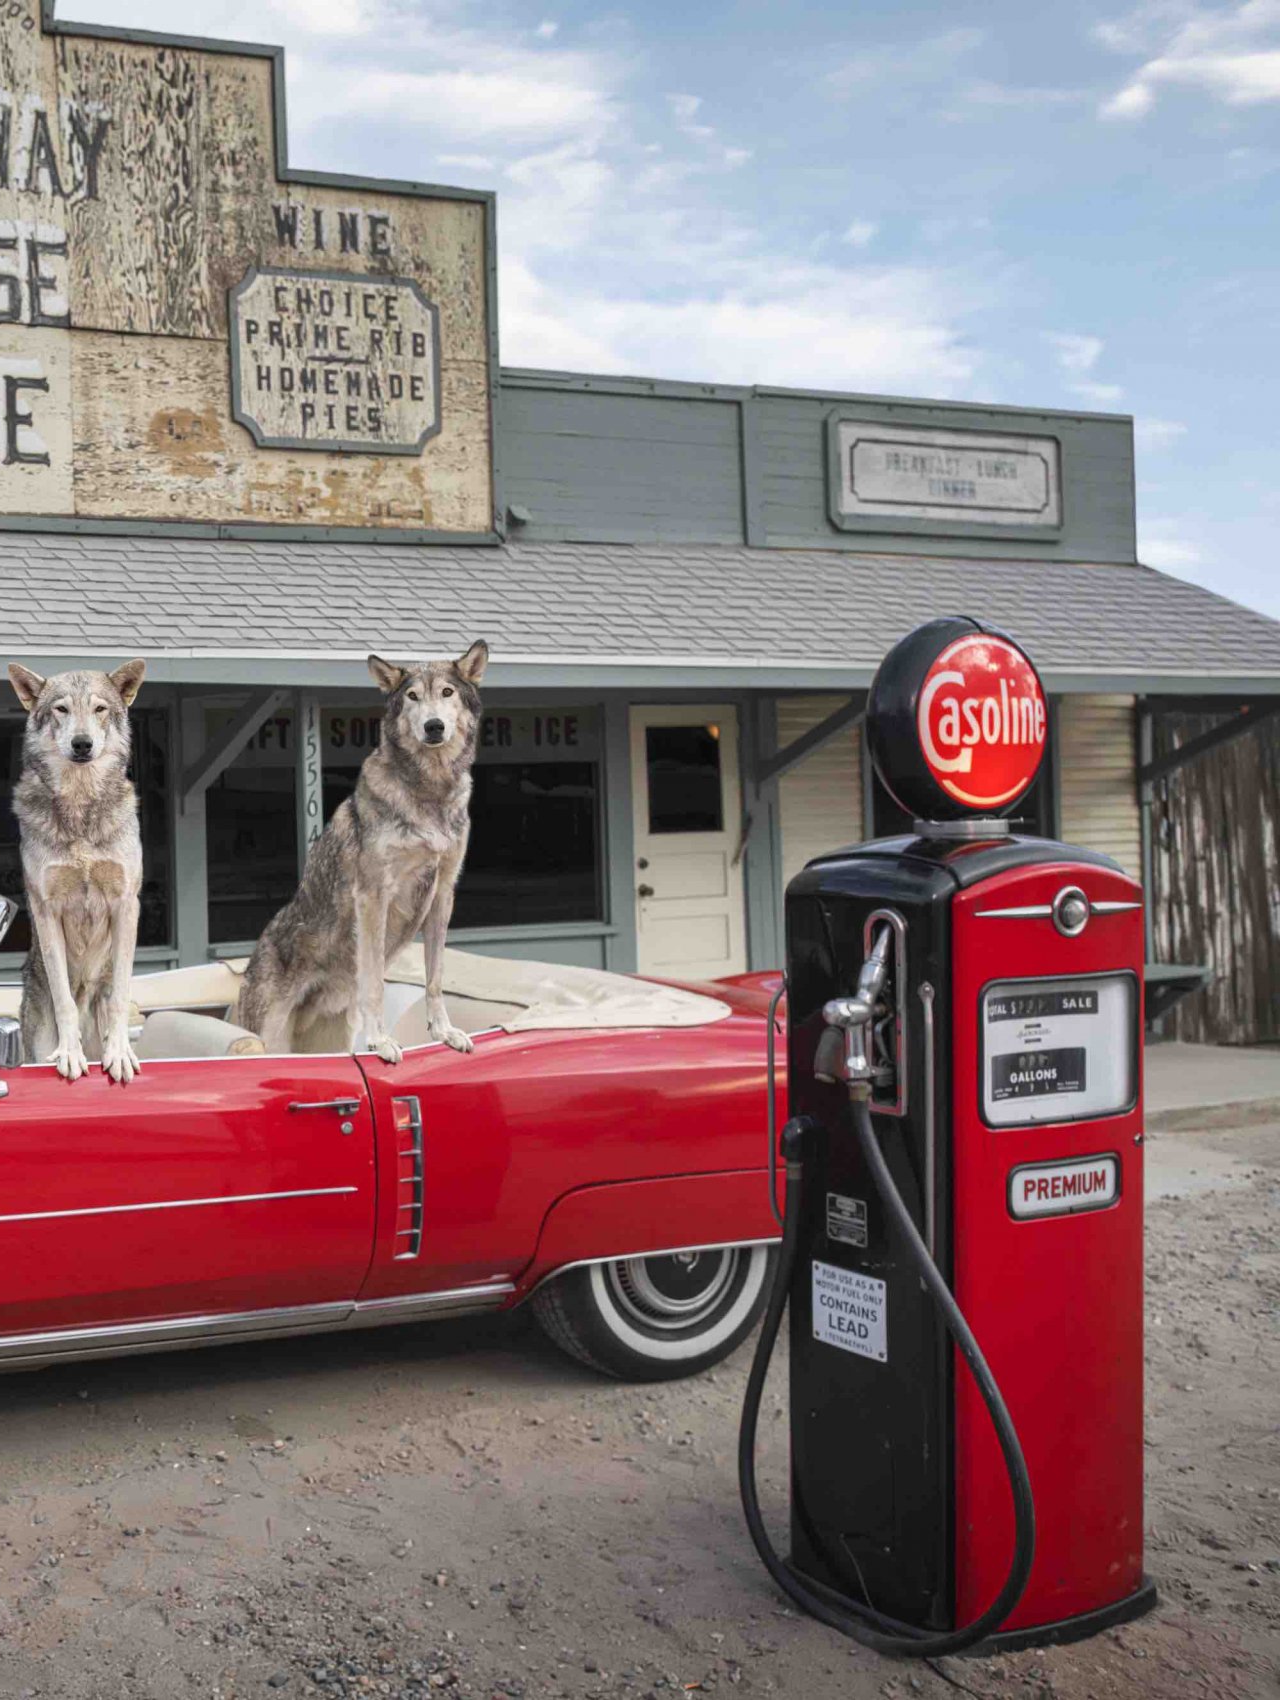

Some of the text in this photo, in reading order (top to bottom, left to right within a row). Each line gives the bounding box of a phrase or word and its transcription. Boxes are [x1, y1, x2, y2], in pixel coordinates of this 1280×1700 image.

[272, 203, 392, 256] WINE
[274, 285, 399, 322] CHOICE
[245, 318, 426, 358] PRIME RIB
[257, 364, 425, 402] HOMEMADE
[301, 402, 382, 433] PIES
[331, 717, 381, 748] SOD
[533, 714, 579, 747] ICE
[919, 671, 1046, 773] Gasoline
[1062, 996, 1093, 1010] SALE
[1009, 1067, 1058, 1084] GALLONS
[1023, 1168, 1107, 1202] PREMIUM
[816, 1279, 884, 1306] MOTOR FUEL ONLY
[822, 1268, 875, 1292] FOR USE AS A
[820, 1293, 878, 1323] CONTAINS
[828, 1312, 870, 1340] LEAD
